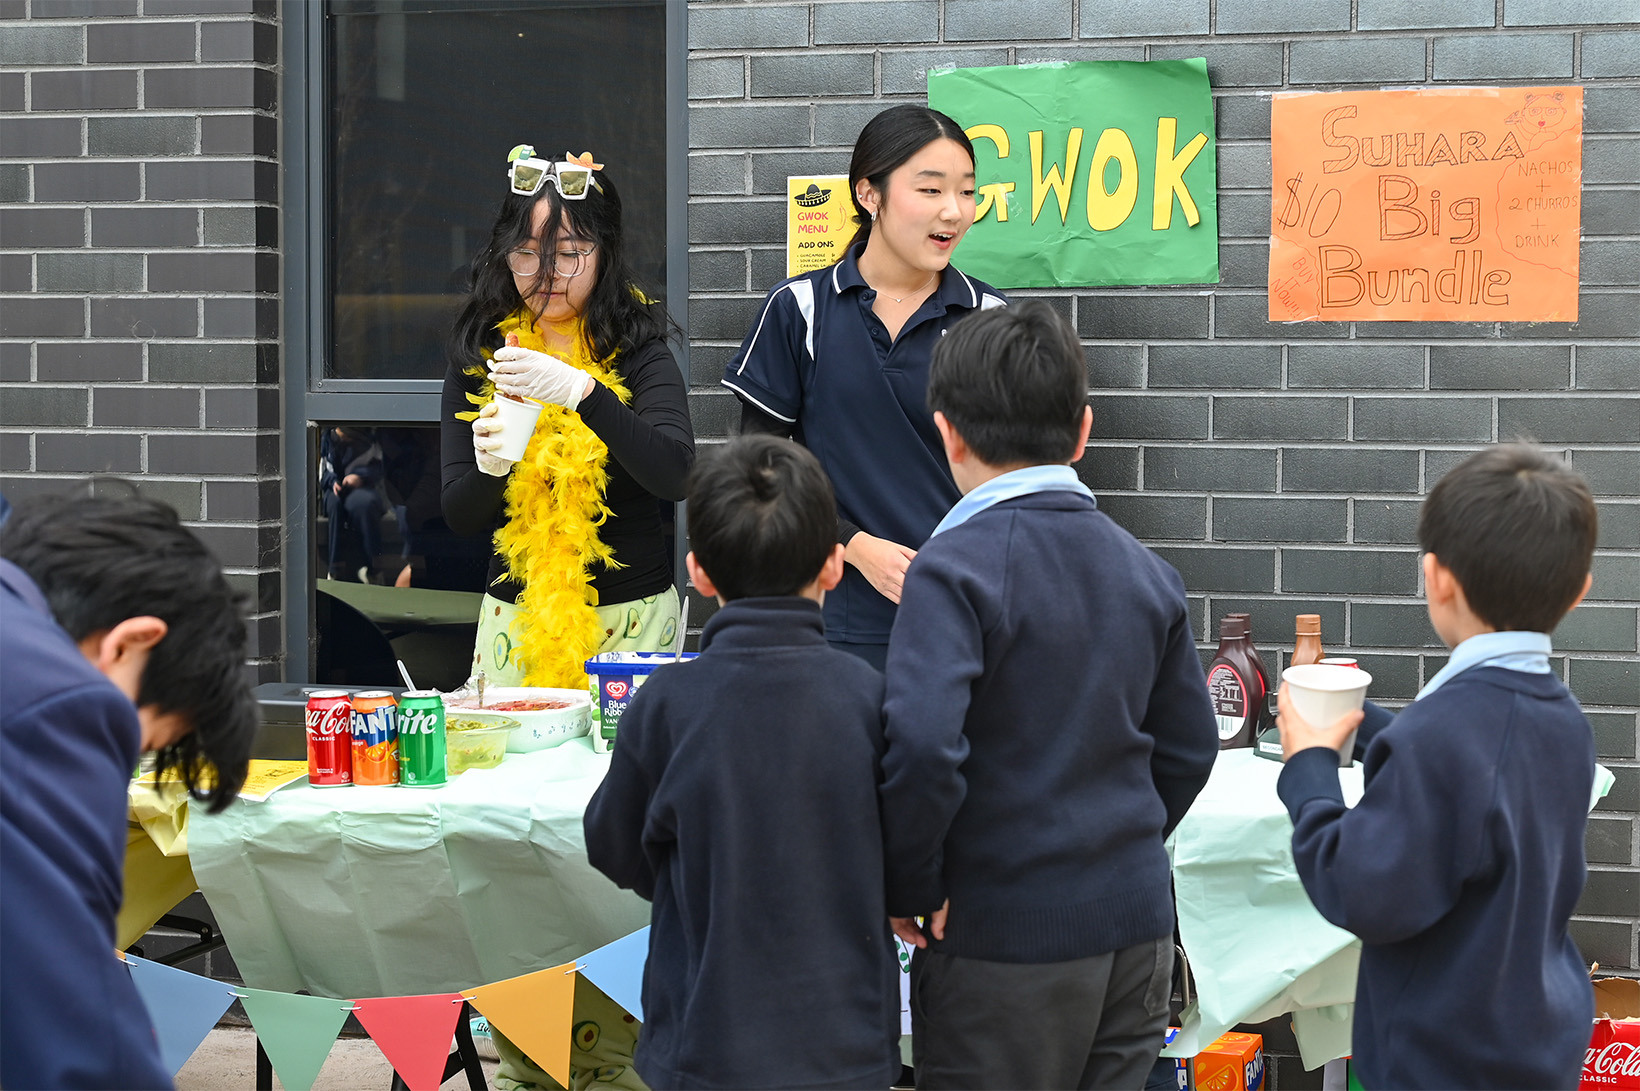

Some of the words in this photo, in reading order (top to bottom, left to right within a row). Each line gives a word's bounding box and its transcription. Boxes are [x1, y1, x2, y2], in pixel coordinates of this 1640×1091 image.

[1321, 104, 1525, 175] SUHARA
[962, 115, 1209, 232] GWOK
[1518, 160, 1573, 177] NACHOS
[1276, 171, 1342, 238] $10
[1378, 174, 1482, 245] Big
[1508, 197, 1522, 211] 2
[1526, 195, 1578, 212] CHURROS
[797, 211, 829, 222] GWOK
[797, 224, 829, 234] MENU
[798, 241, 815, 249] ADD
[817, 240, 834, 248] ONS
[1515, 234, 1560, 249] DRINK
[1292, 256, 1315, 285] BUY
[1318, 245, 1512, 309] Bundle
[1285, 276, 1301, 291] IT
[604, 707, 624, 717] Ribb
[608, 700, 627, 709] Blue
